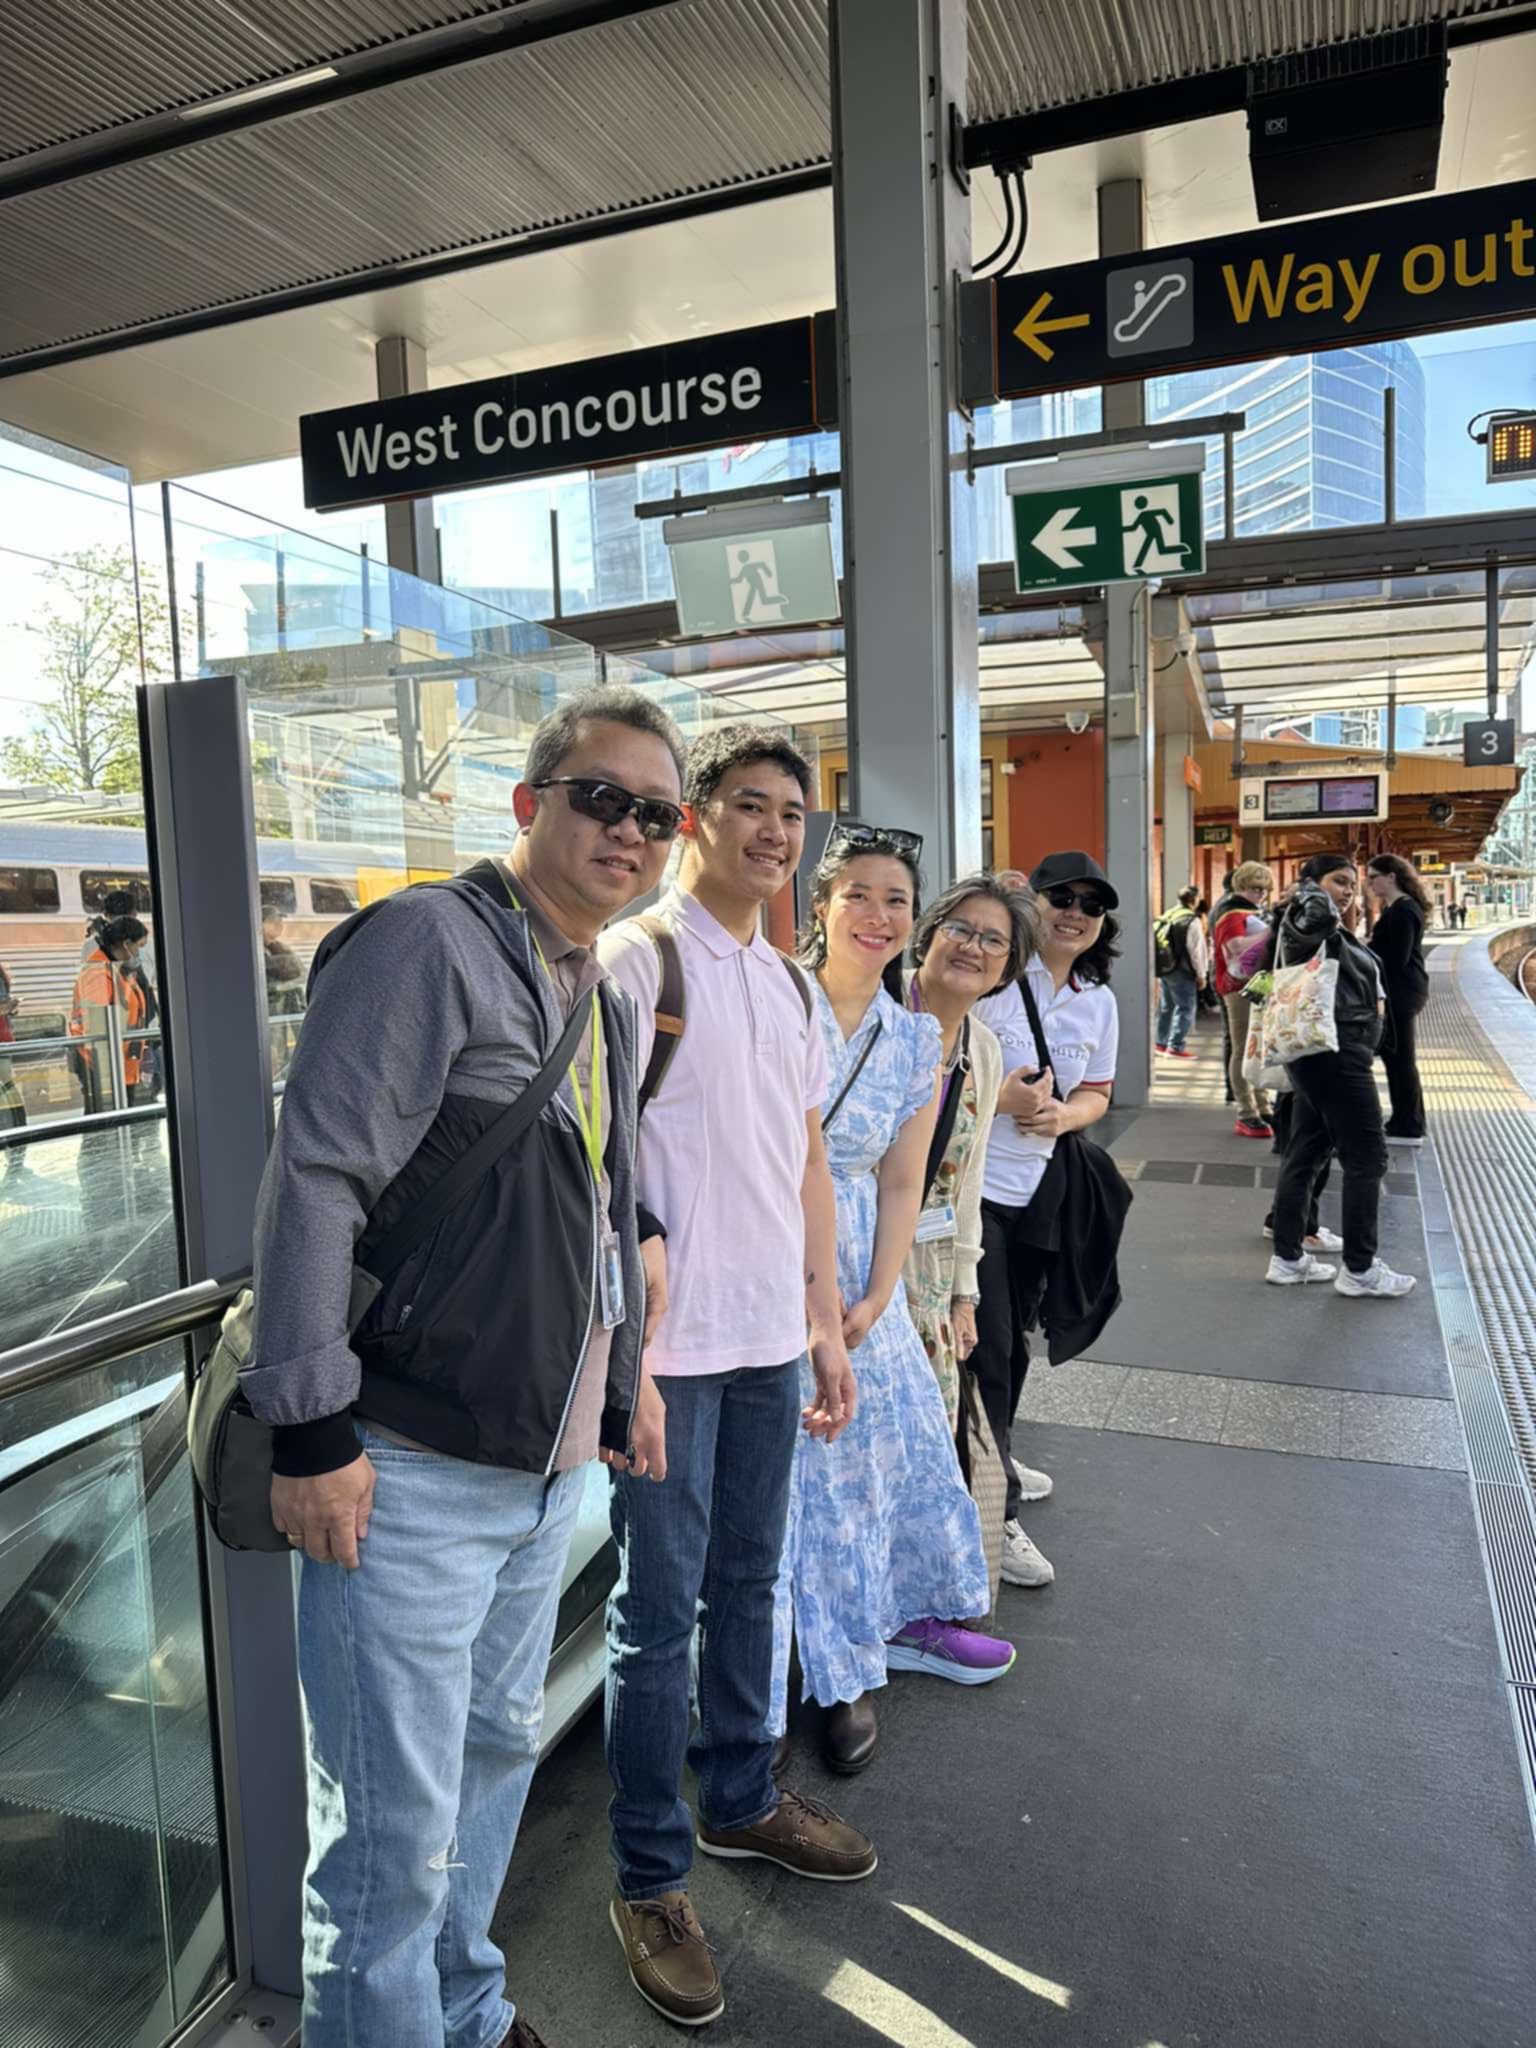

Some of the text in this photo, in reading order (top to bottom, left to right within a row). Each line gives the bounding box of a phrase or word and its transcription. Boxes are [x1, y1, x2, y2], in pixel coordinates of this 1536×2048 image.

[1222, 218, 1535, 323] Way out
[336, 366, 763, 478] West Concourse
[1480, 730, 1499, 756] 3
[1247, 795, 1257, 808] 3
